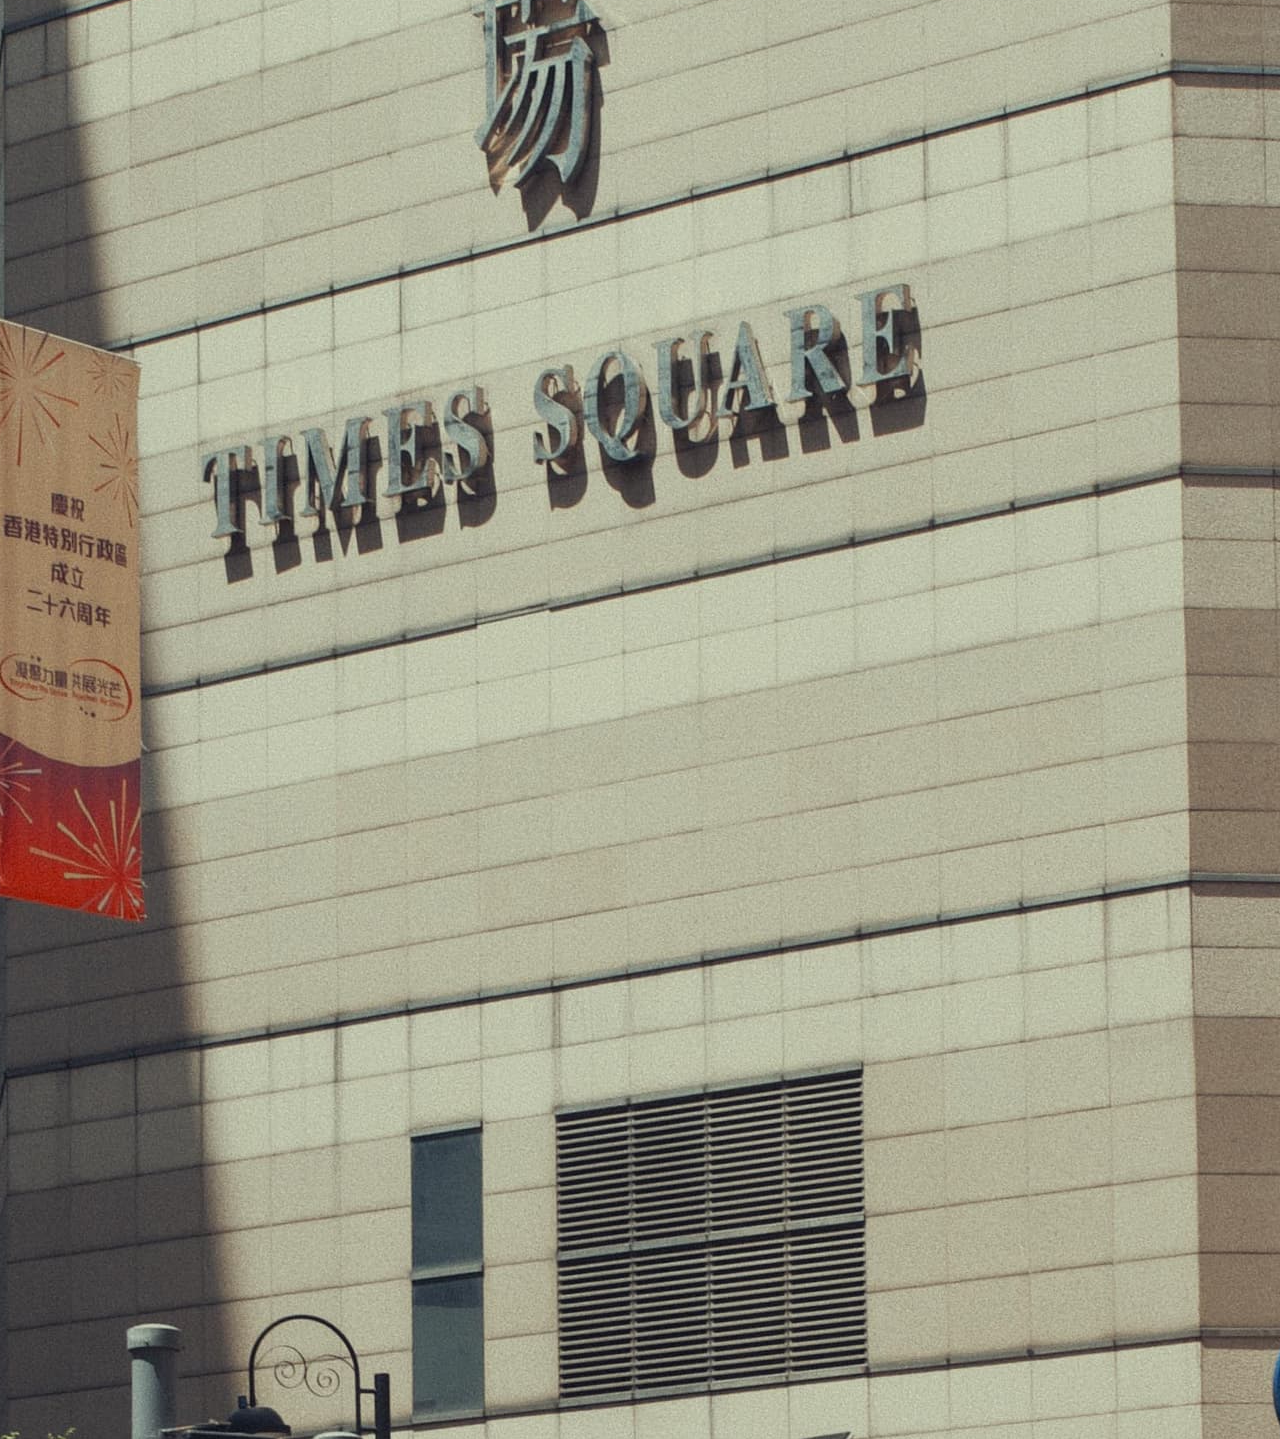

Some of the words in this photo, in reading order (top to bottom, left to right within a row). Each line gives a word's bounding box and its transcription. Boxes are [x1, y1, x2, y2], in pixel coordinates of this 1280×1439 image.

[202, 385, 490, 538] TIMES
[533, 282, 918, 463] SQUARE
[51, 492, 84, 522] 慶祝
[3, 514, 127, 568] 香港特別行政區
[51, 561, 84, 590] 成立
[26, 589, 111, 628] 二十六周年
